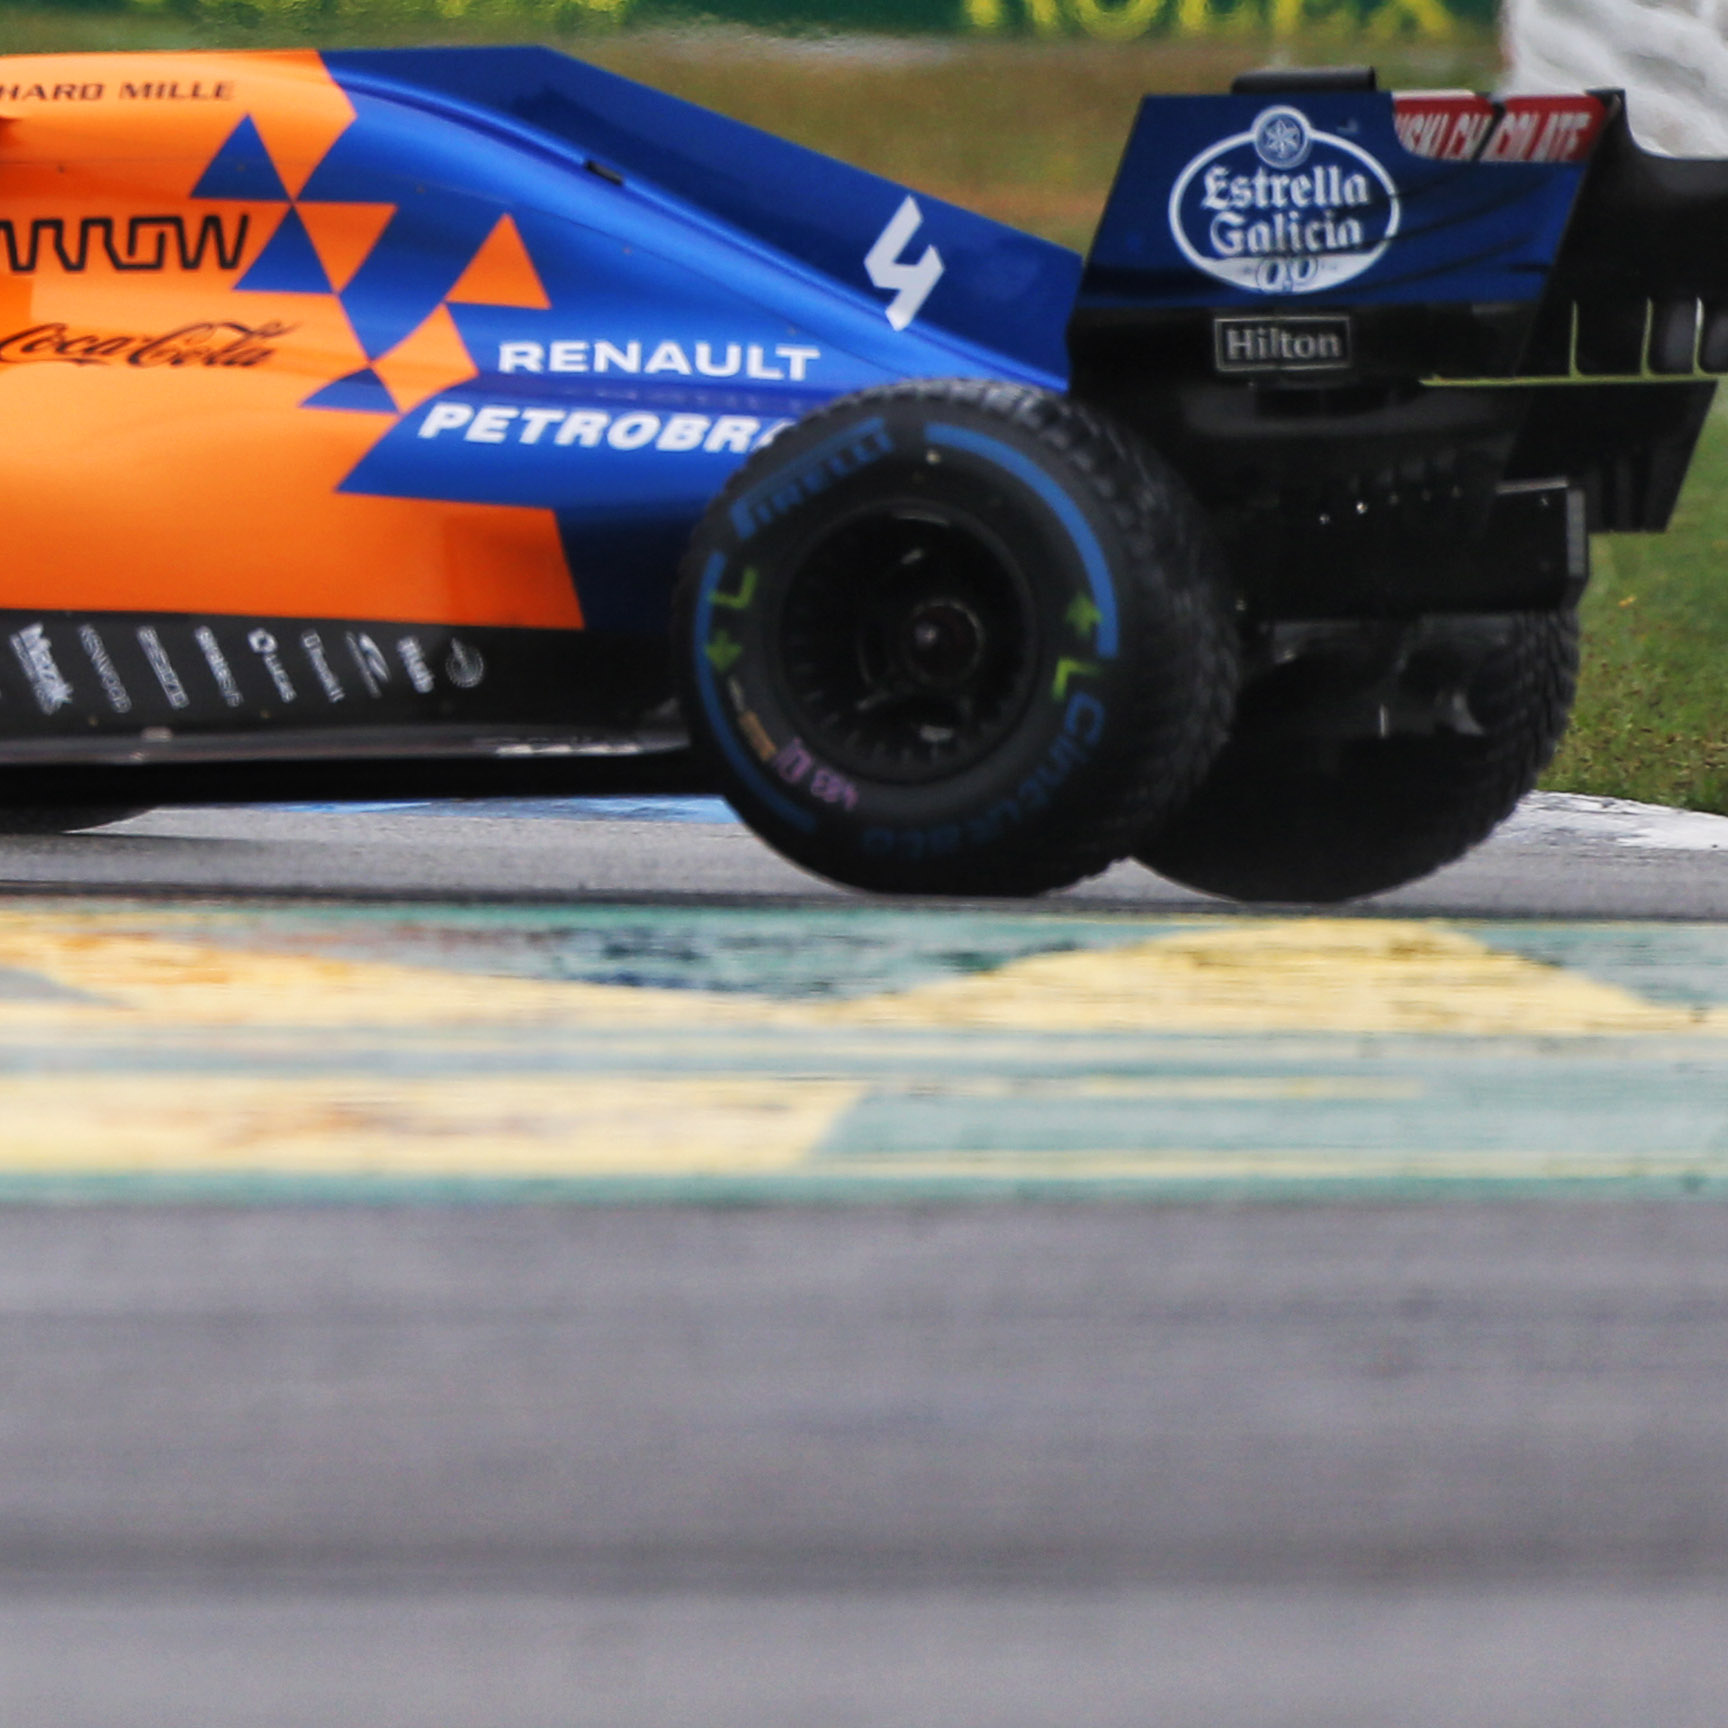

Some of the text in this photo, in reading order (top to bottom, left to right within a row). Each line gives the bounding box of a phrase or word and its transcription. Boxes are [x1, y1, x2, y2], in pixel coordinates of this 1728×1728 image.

[119, 80, 236, 101] MILLE
[1201, 165, 1370, 209] Estrella
[1209, 210, 1362, 255] Galicia
[864, 195, 944, 331] 4
[498, 341, 820, 381] RENAULT
[1227, 327, 1342, 360] Hilton
[730, 416, 894, 540] PIRELLI
